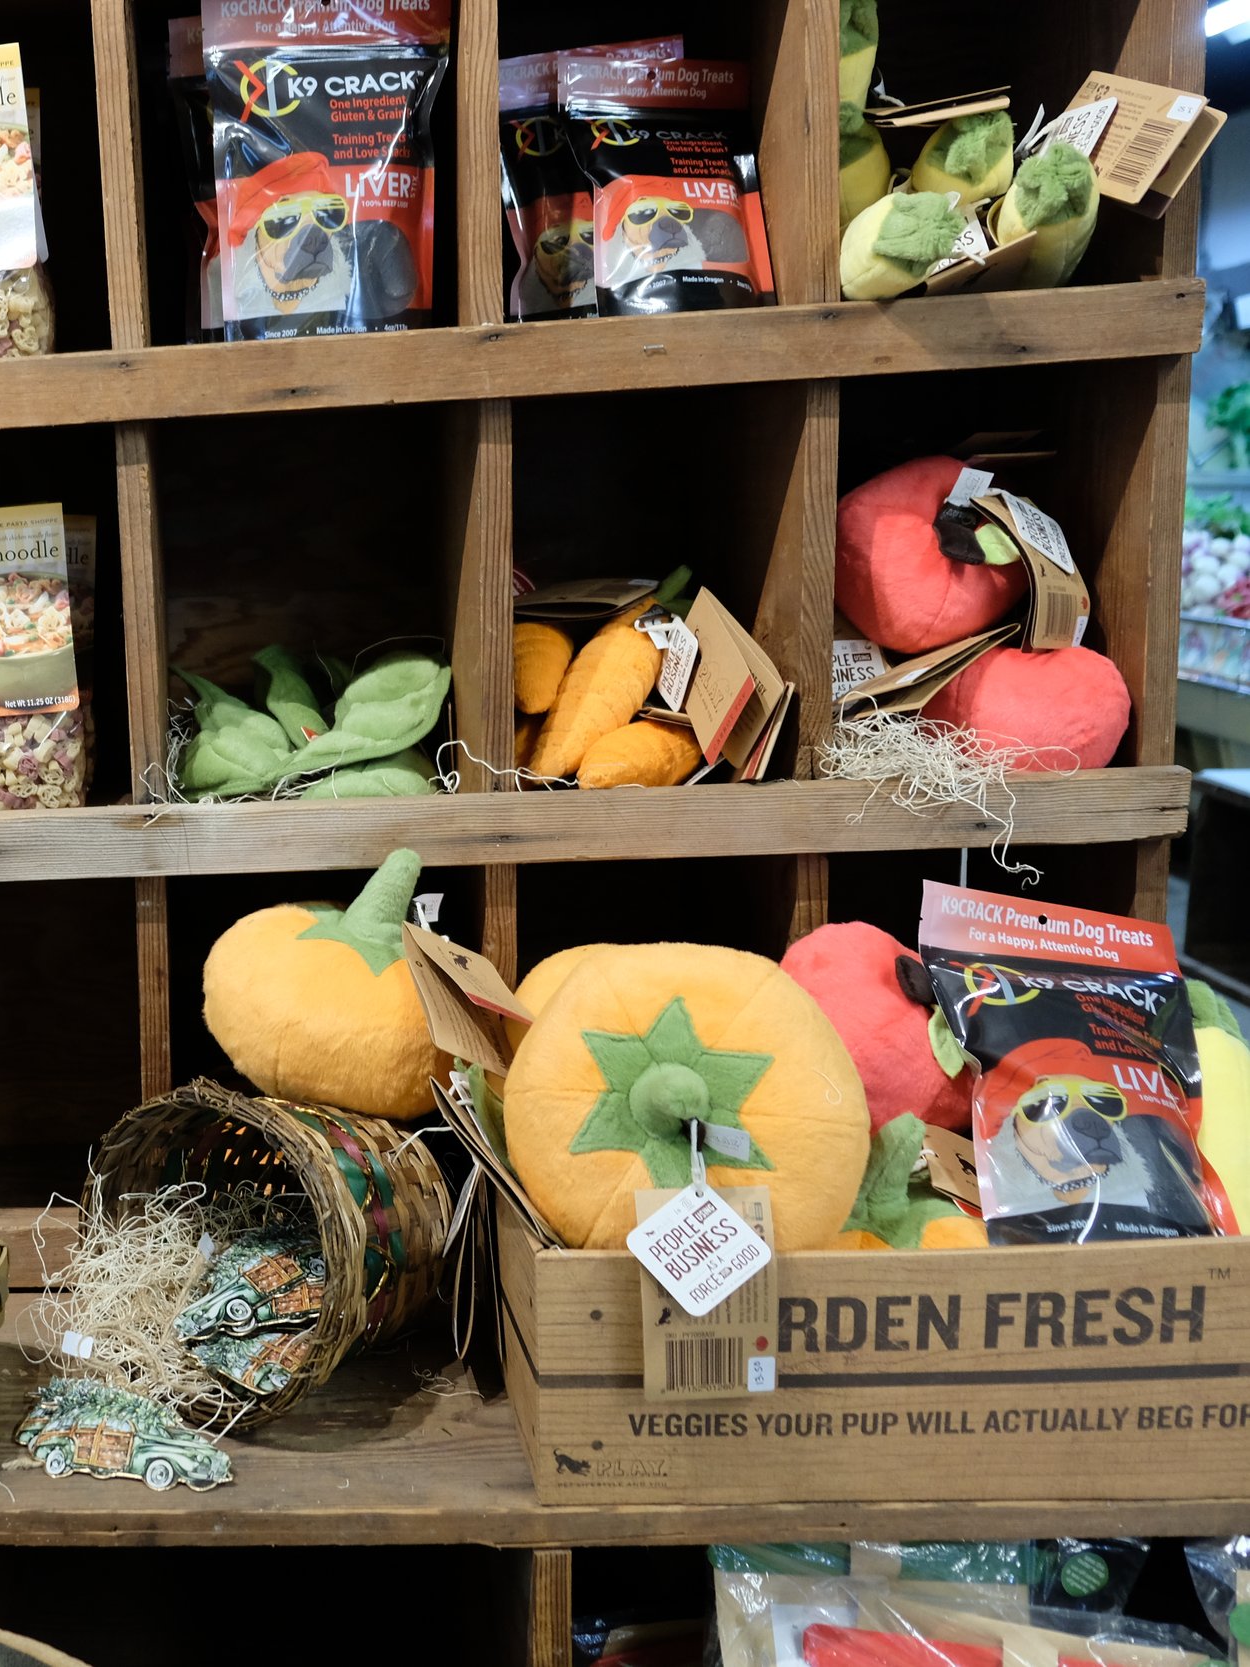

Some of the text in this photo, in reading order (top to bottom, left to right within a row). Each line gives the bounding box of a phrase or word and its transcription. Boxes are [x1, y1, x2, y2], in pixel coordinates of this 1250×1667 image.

[255, 21, 273, 33] For
[275, 24, 281, 32] a
[626, 67, 675, 82] Preum
[678, 68, 699, 85] Dog
[701, 69, 735, 83] Treats
[288, 75, 318, 98] K9
[651, 87, 688, 97] Attentive
[689, 88, 706, 99] Dog
[330, 95, 406, 110] One Ingredient
[331, 108, 403, 122] Gluten & Grain
[332, 132, 373, 147] Training
[627, 129, 650, 138] K9
[333, 147, 353, 159] and
[355, 147, 379, 158] Love
[670, 157, 728, 167] Training Treats
[673, 166, 687, 174] and
[689, 166, 708, 174] Love
[345, 171, 410, 198] LIVER
[682, 181, 738, 200] LIVER
[704, 277, 724, 285] Oregon
[264, 329, 281, 339] Since
[282, 327, 298, 337] 2007
[316, 326, 334, 335] Made
[343, 325, 367, 336] Oregon
[6, 520, 29, 528] PASTA
[30, 517, 58, 526] SHOPPE
[832, 653, 851, 667] PLE
[832, 666, 876, 682] SINESS
[4, 700, 16, 709] Net
[16, 699, 26, 707] Wt
[26, 698, 44, 707] 11.25
[44, 696, 54, 705] OZ
[941, 896, 1004, 924] K9CRACK
[1073, 918, 1104, 945] Dog
[1106, 923, 1154, 948] Treats
[969, 926, 1119, 962] For a Happy, Attentive Dog
[1021, 976, 1054, 990] K9
[1094, 1039, 1117, 1051] and
[1113, 1063, 1161, 1098] LIV
[1046, 1220, 1179, 1237] Since 200 Made in Oregon
[648, 1215, 701, 1263] PEOPLE
[664, 1217, 739, 1281] BUSINESS
[730, 1243, 760, 1272] GOOD
[707, 1262, 719, 1274] AS
[689, 1272, 724, 1304] FORCE
[778, 1294, 962, 1353] RDEN
[983, 1285, 1206, 1350] FRESH
[628, 1413, 748, 1438] VEGGIES
[756, 1412, 834, 1437] YOUR
[841, 1411, 899, 1436] PUP
[905, 1410, 976, 1435] WILL
[982, 1406, 1130, 1434] ACTUALLY
[1137, 1404, 1194, 1430] BEG
